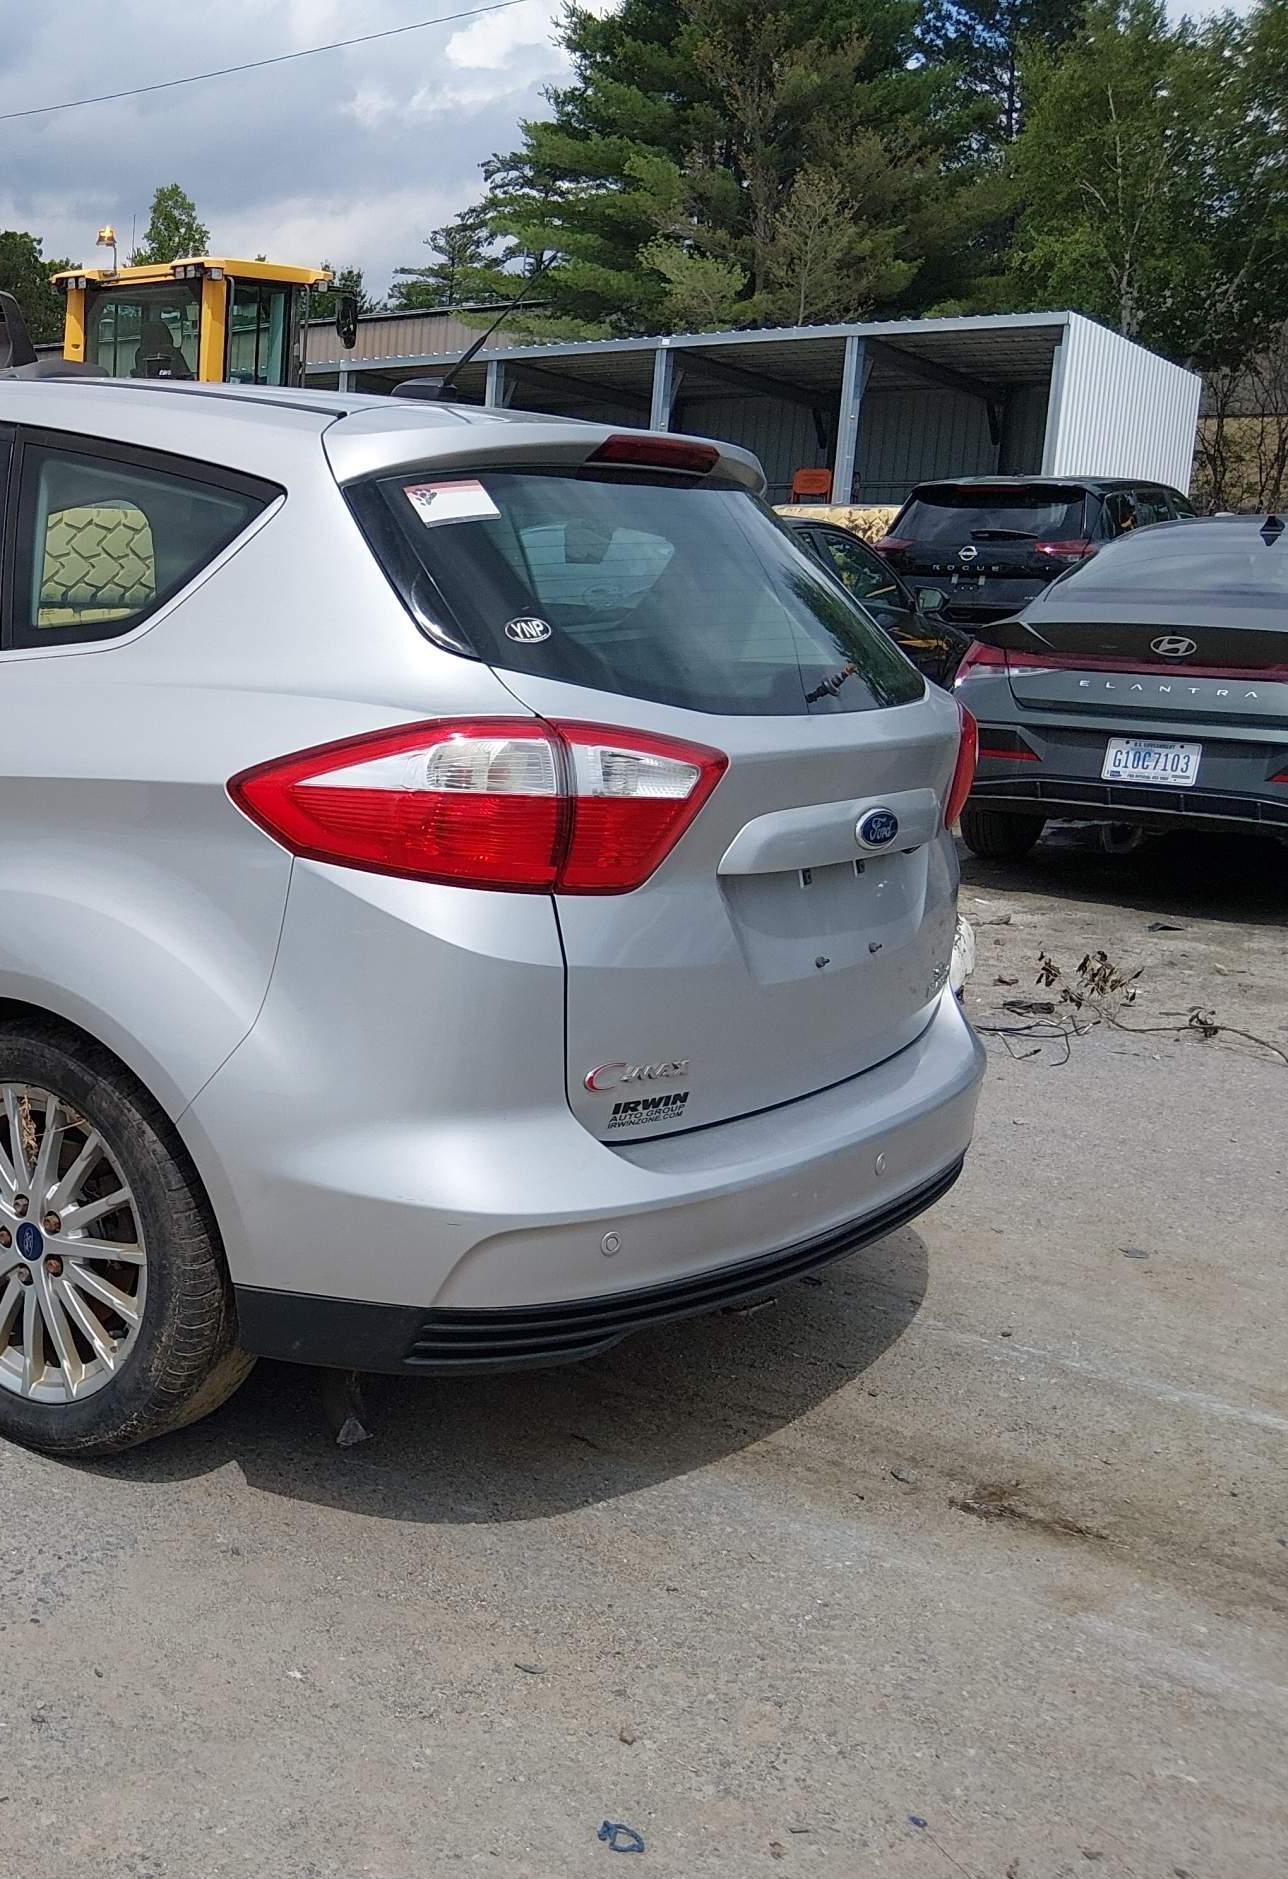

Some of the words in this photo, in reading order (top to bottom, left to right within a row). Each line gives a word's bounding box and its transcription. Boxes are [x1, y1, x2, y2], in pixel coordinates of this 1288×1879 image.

[510, 620, 544, 639] YNP
[1079, 680, 1258, 698] ELANTRA
[869, 816, 894, 841] Ford
[609, 1111, 643, 1123] AUTO
[646, 1103, 686, 1116] GROUP
[612, 1091, 690, 1115] IRWIN
